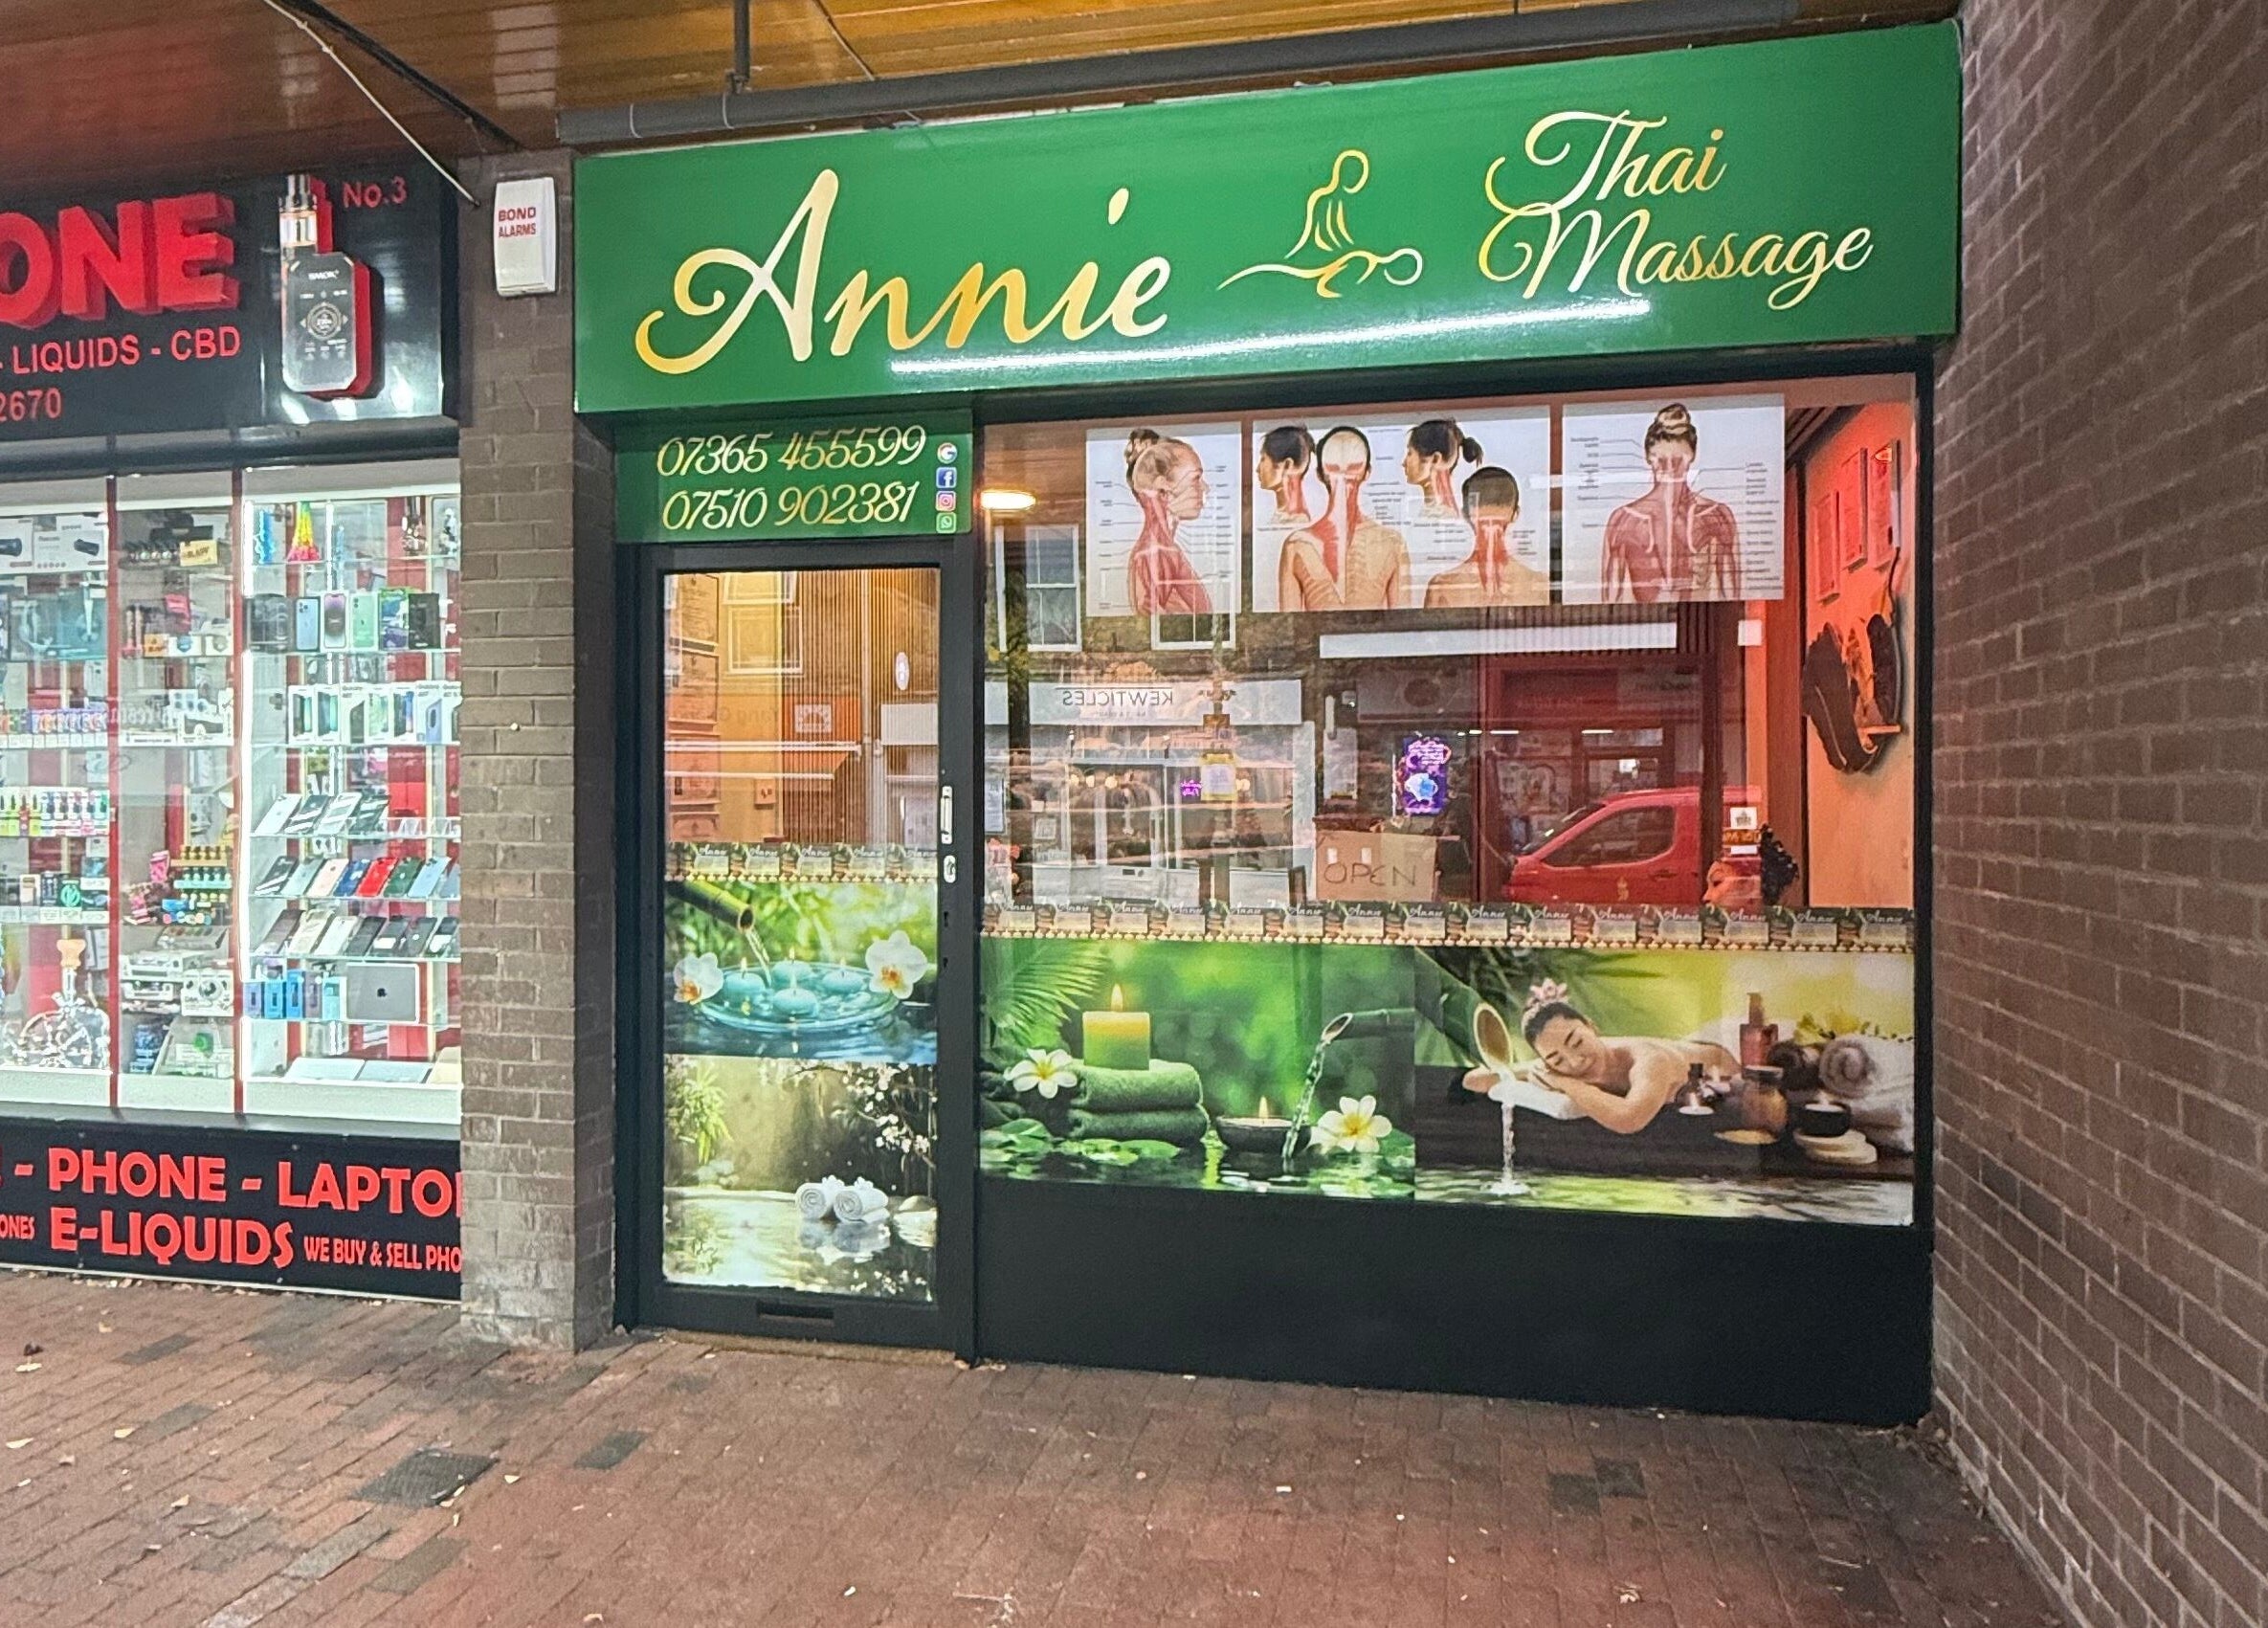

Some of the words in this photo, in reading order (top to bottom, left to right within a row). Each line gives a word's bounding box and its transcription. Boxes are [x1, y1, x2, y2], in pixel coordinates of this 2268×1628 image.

[1484, 109, 1728, 215] Thai
[498, 207, 537, 222] BOND
[498, 223, 537, 238] ALARMS
[0, 191, 240, 331] ONE
[634, 168, 1170, 374] Annie
[1478, 202, 1875, 311] Massage
[12, 334, 141, 374] LIQUIDS
[170, 325, 240, 361] CBD
[656, 431, 773, 477] 07365
[778, 425, 926, 471] 455599
[662, 486, 768, 530] 07510
[774, 480, 921, 526] 902381
[1323, 862, 1416, 886] OPEN
[48, 1148, 227, 1202] PHONE
[278, 1161, 461, 1218] LAPTO
[50, 1207, 294, 1269] E-LIQUIDS
[303, 1236, 330, 1262] WE
[333, 1238, 367, 1266] BUY
[369, 1240, 383, 1267] &
[386, 1242, 423, 1270] SELL
